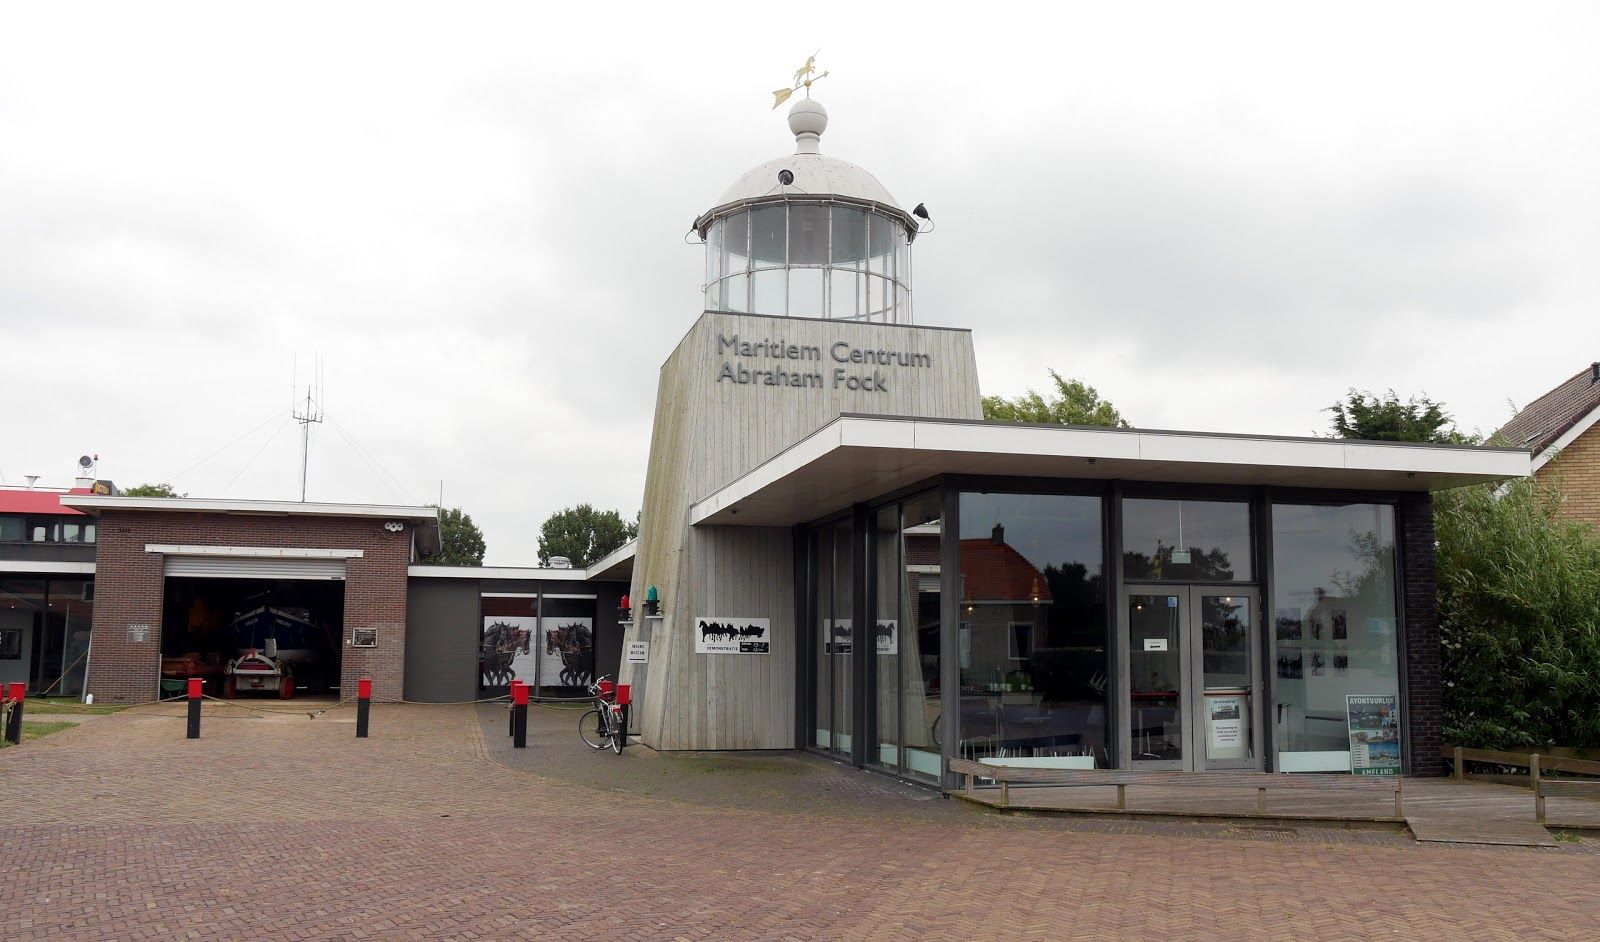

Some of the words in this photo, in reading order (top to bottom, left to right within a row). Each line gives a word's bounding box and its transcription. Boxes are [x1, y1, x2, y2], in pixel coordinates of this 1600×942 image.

[717, 333, 821, 361] Maritiem
[830, 341, 932, 368] Centrum
[716, 361, 824, 388] Abraham
[832, 368, 888, 392] Fock
